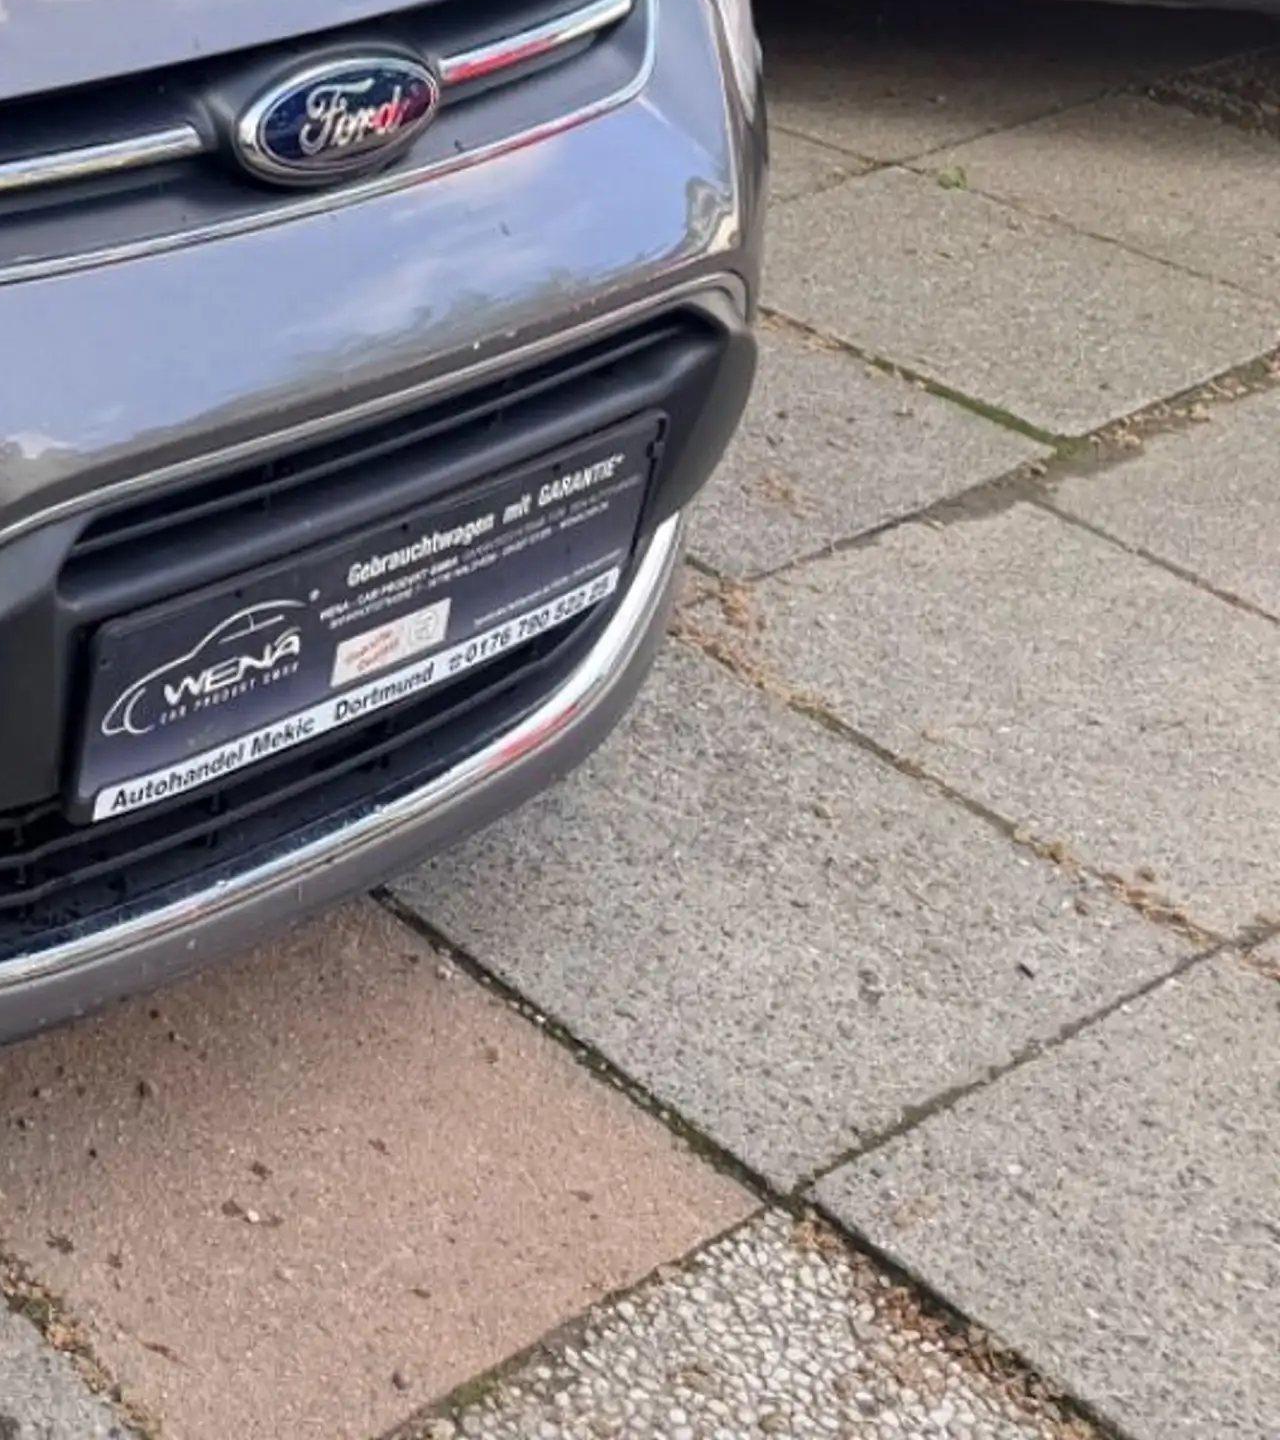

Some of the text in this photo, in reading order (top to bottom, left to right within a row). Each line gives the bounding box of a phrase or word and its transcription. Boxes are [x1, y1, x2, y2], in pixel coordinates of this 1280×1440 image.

[299, 77, 404, 156] Ford
[346, 514, 495, 588] Gebrauchtwagen
[502, 495, 532, 525] mit
[164, 627, 302, 706] WENA
[111, 744, 244, 810] Autohandel
[250, 717, 315, 758] Mekic
[333, 663, 434, 718] Dortmund
[465, 627, 509, 664] 0176
